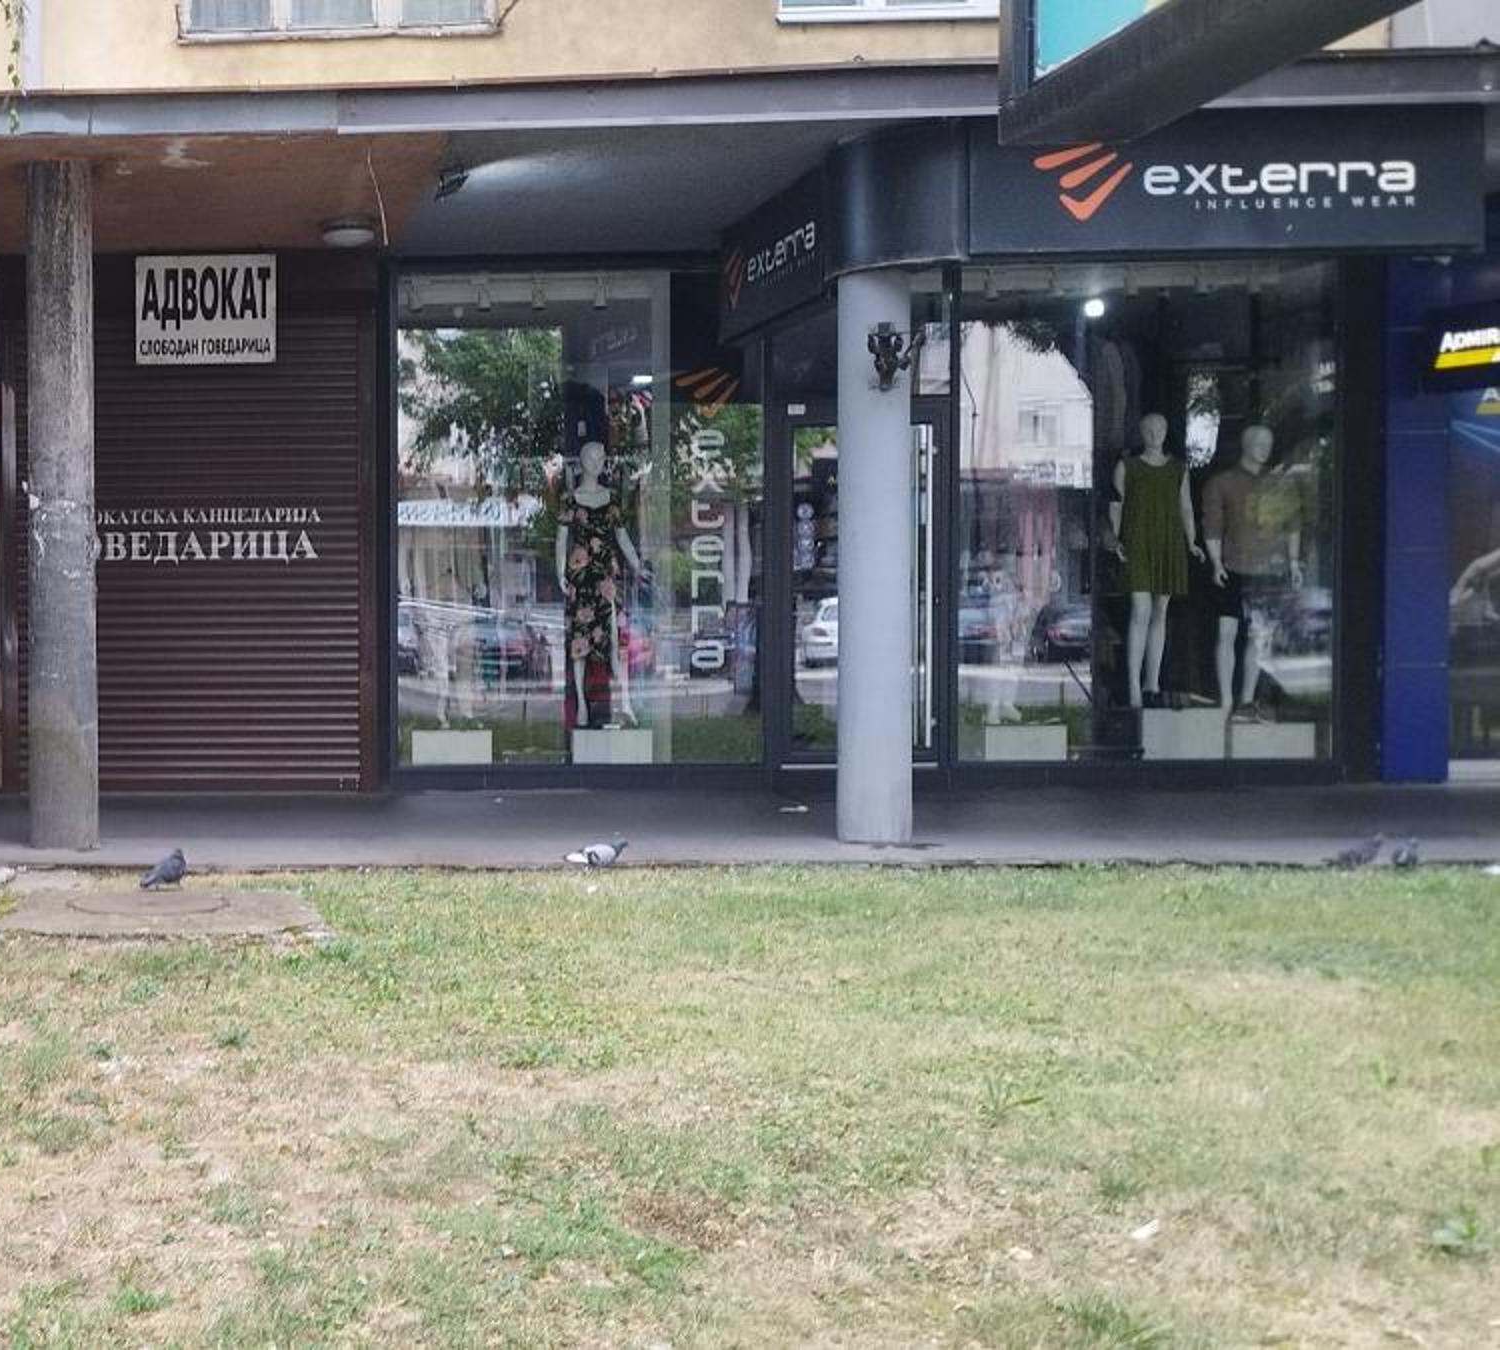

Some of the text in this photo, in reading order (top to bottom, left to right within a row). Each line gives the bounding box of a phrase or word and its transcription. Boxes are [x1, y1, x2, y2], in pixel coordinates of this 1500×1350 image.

[1143, 160, 1416, 195] exterra
[1195, 195, 1416, 210] INFLUENCE WEAR
[747, 220, 816, 281] exterra
[141, 265, 271, 331] АДВОКАТ
[140, 337, 271, 359] СЛОБОДАН ГОВЕДАРИЦА
[183, 507, 322, 524] КАНЦЕЛАРИЈА
